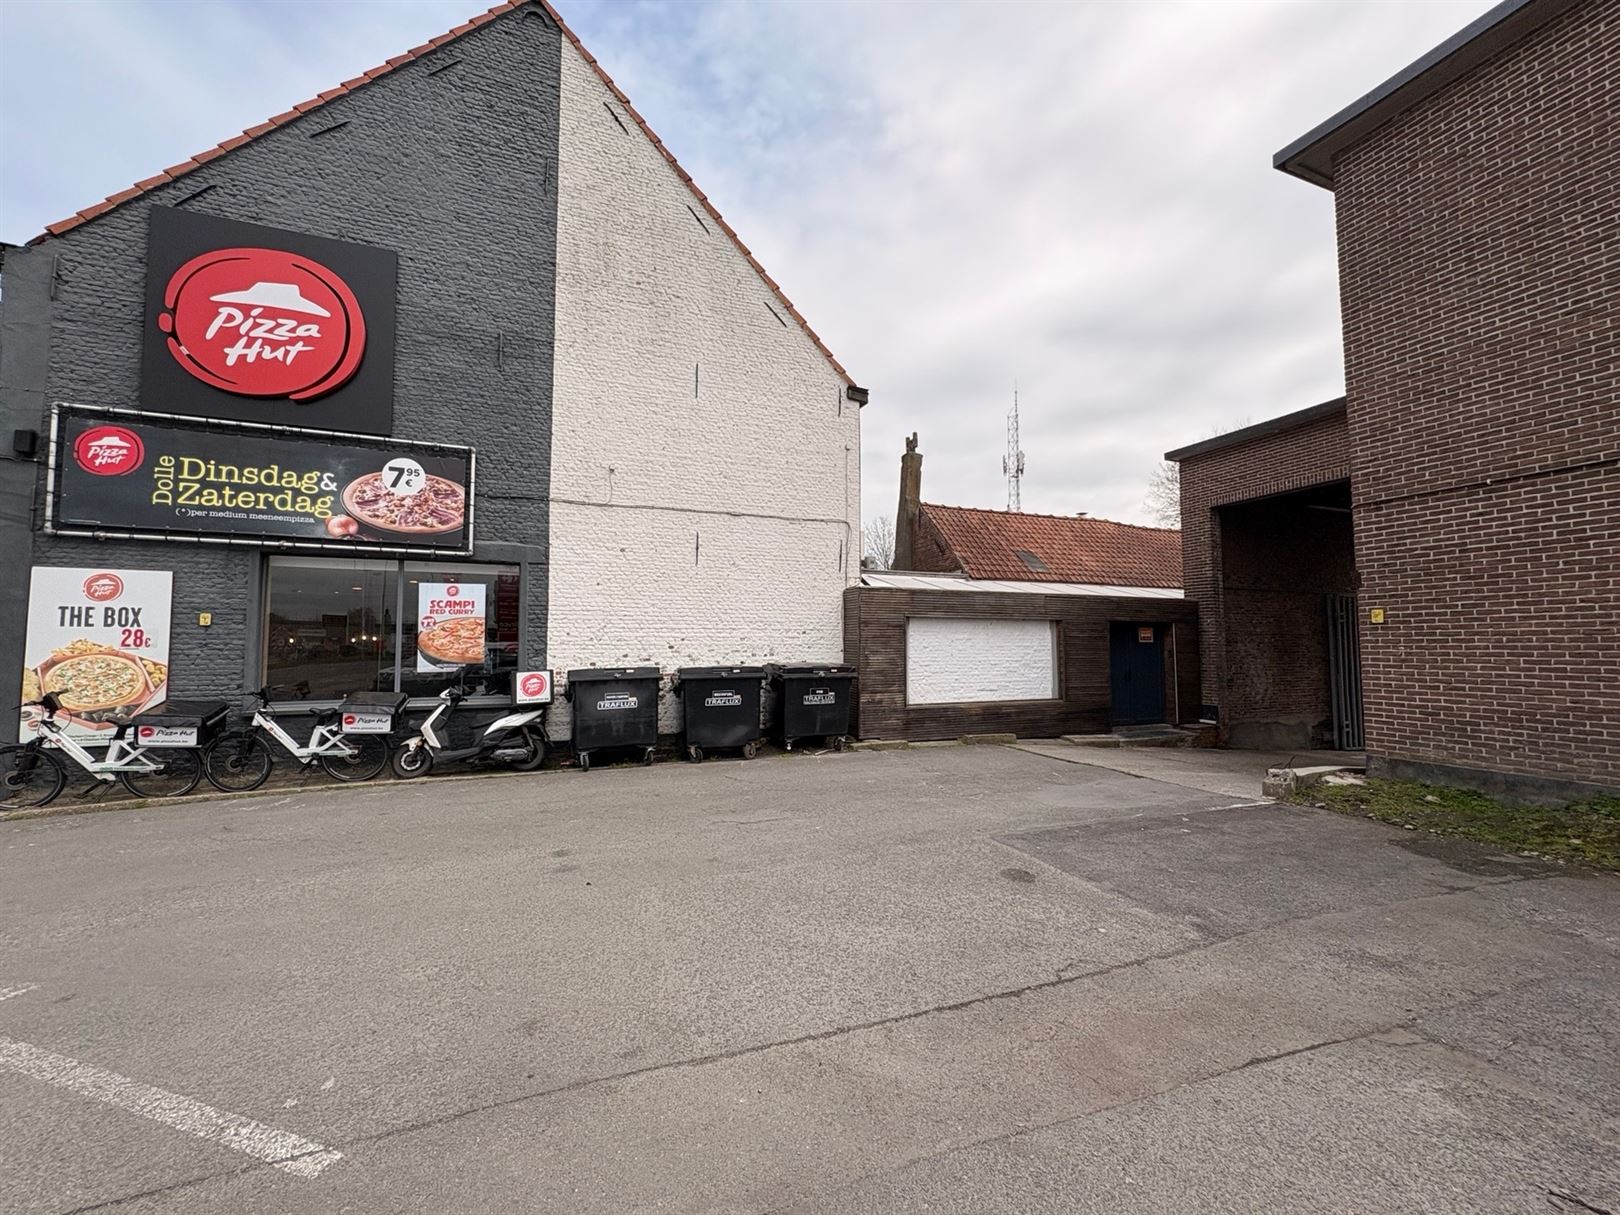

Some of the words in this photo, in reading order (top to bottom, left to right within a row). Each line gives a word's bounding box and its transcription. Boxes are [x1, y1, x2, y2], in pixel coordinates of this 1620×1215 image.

[205, 307, 322, 340] Pizza
[223, 336, 315, 366] Hut
[88, 445, 128, 459] Pizza
[94, 455, 126, 467] Hut
[152, 455, 175, 506] Dolle
[177, 482, 334, 519] Zaterdag
[209, 510, 247, 519] medium
[249, 513, 315, 524] meeneempizza
[429, 600, 475, 608] SCAMPI
[58, 606, 95, 627] THE
[103, 607, 142, 627] BOX
[600, 700, 636, 708] TRAFLUX
[156, 729, 178, 737] Pizza
